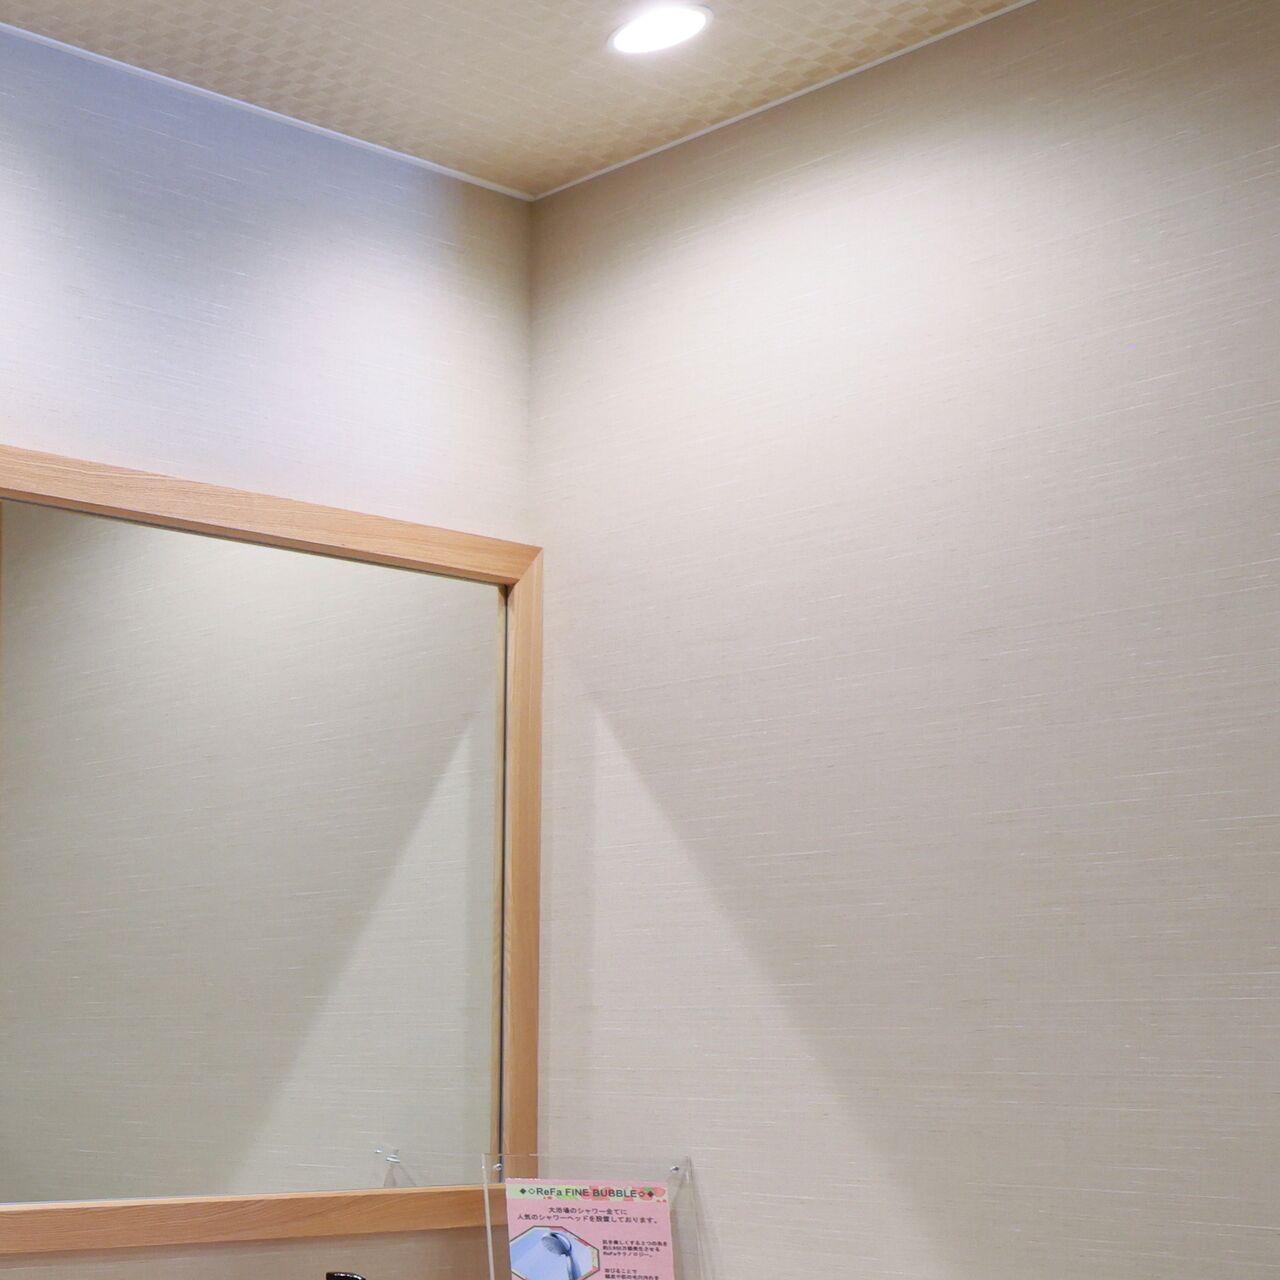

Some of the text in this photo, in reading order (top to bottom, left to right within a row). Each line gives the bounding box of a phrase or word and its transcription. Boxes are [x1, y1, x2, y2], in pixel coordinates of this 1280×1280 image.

[536, 1187, 638, 1198] ReFa FINE BUBBLE
